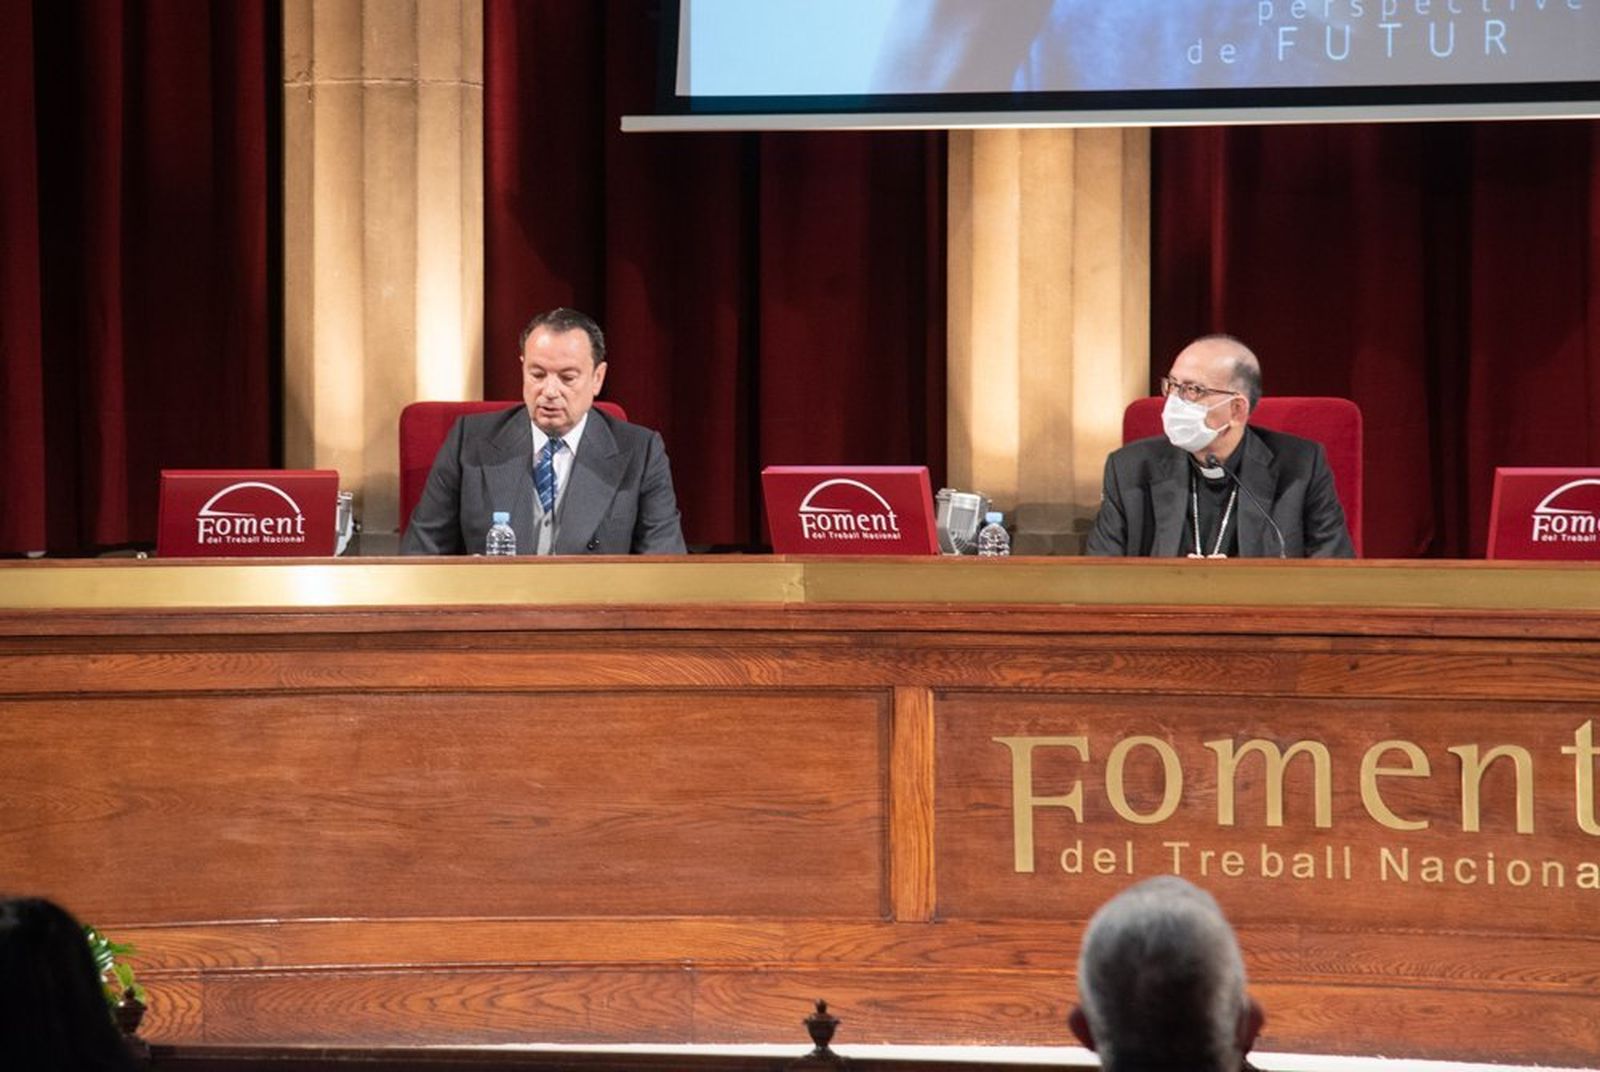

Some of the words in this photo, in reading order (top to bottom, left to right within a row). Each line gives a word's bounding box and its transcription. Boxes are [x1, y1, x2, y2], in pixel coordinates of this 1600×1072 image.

[1187, 38, 1236, 64] de
[1277, 19, 1508, 62] FUTUR
[196, 513, 306, 544] Foment
[207, 536, 222, 544] del
[262, 535, 305, 544] Nacional
[798, 510, 900, 539] Foment
[1531, 514, 1600, 542] Fom
[992, 719, 1600, 873] Foment
[1060, 839, 1134, 875] del
[1163, 841, 1351, 880] Treball
